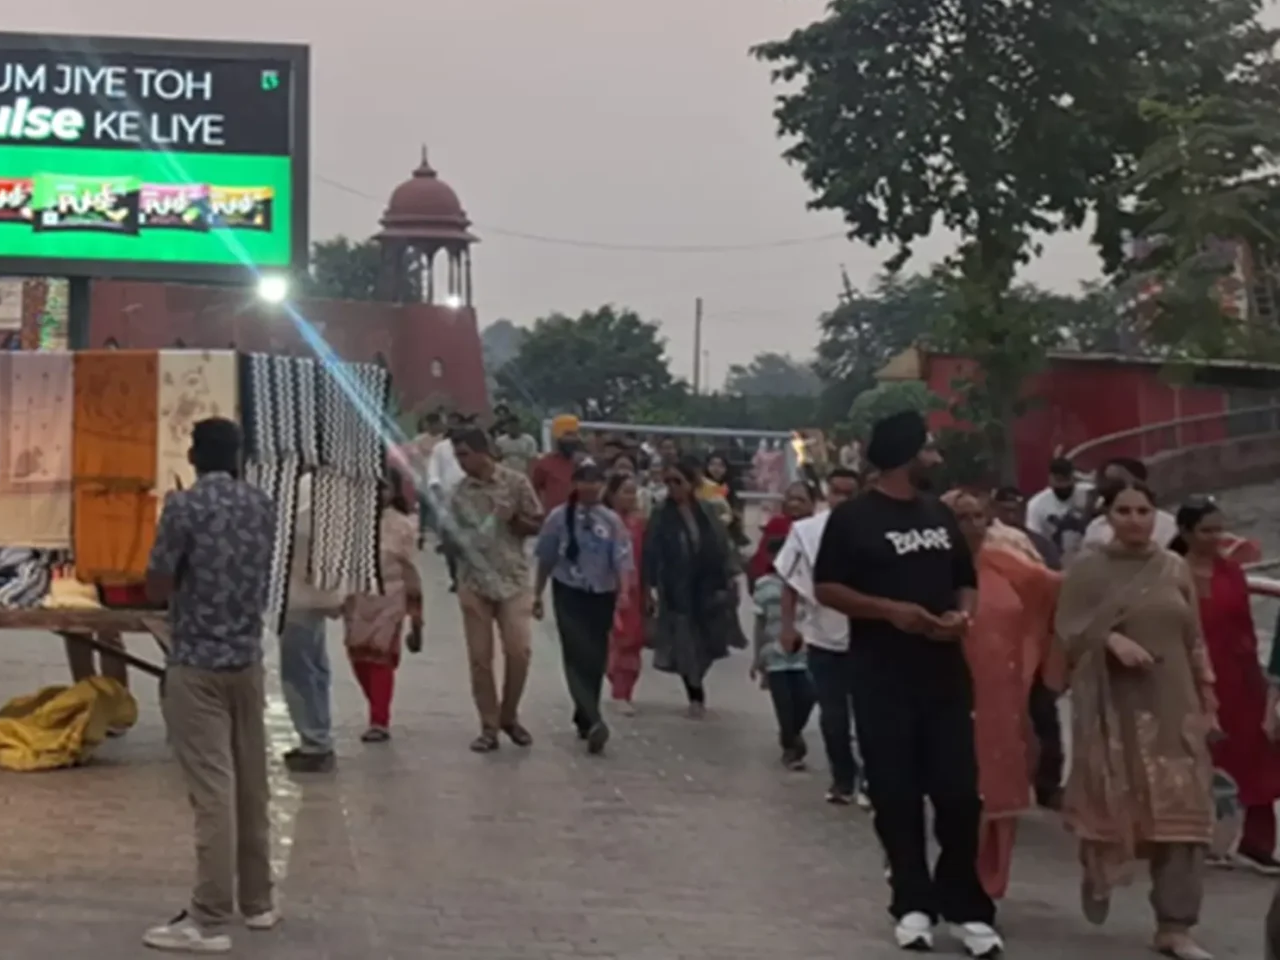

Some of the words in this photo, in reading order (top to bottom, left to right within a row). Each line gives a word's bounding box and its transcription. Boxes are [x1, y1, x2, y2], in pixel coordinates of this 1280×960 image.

[53, 64, 127, 97] JIYE
[134, 68, 212, 100] TOH
[93, 110, 141, 141] KE
[151, 113, 225, 145] LIYE
